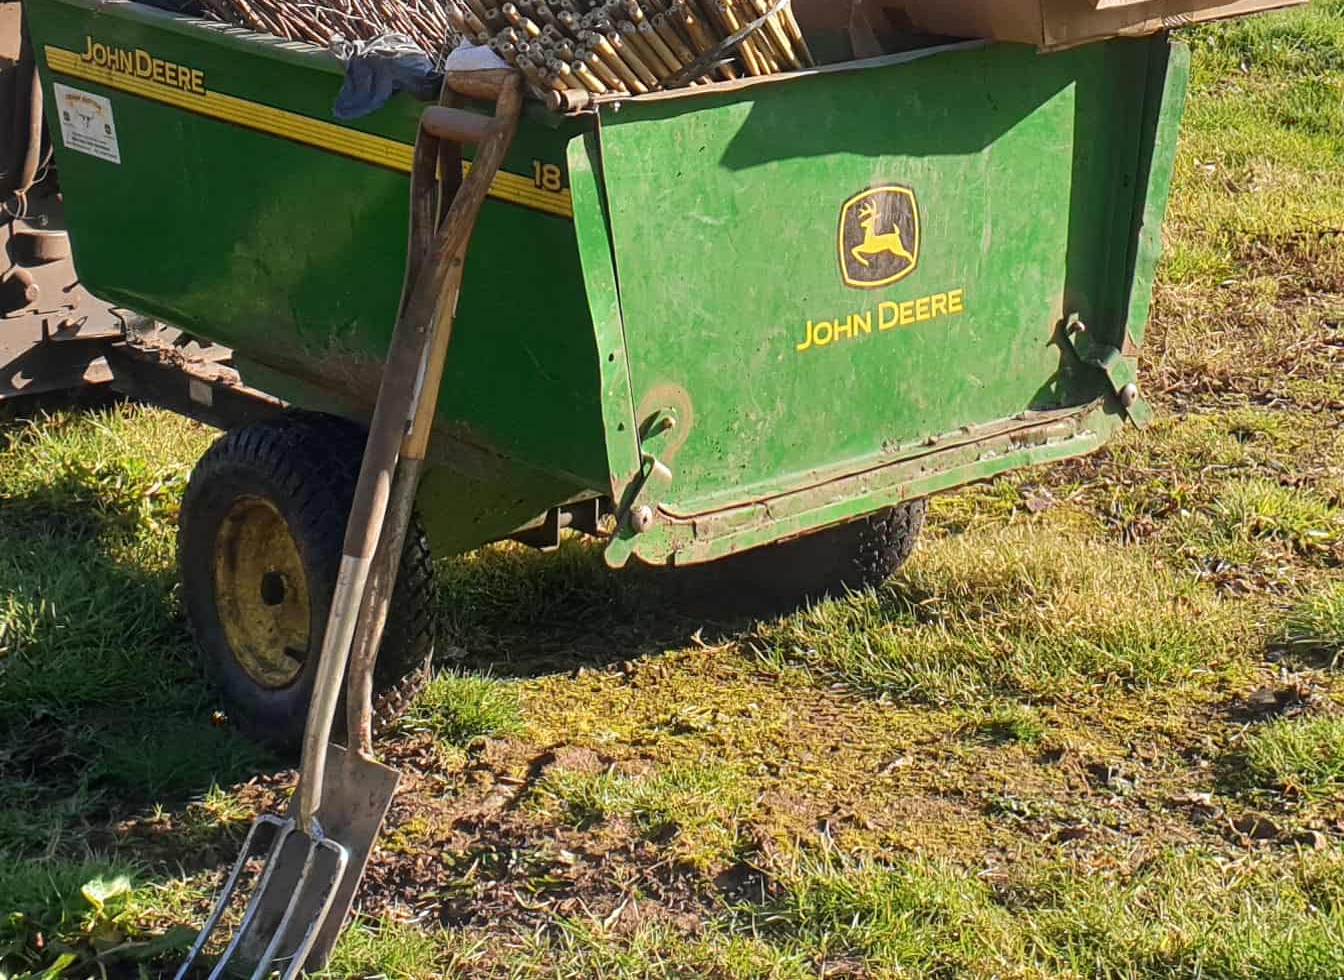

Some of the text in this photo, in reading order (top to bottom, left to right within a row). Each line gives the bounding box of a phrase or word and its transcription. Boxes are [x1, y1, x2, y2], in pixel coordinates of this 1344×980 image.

[81, 35, 206, 95] JOHN DEERE
[533, 159, 561, 191] 18
[796, 288, 964, 352] JOHN DEERE
